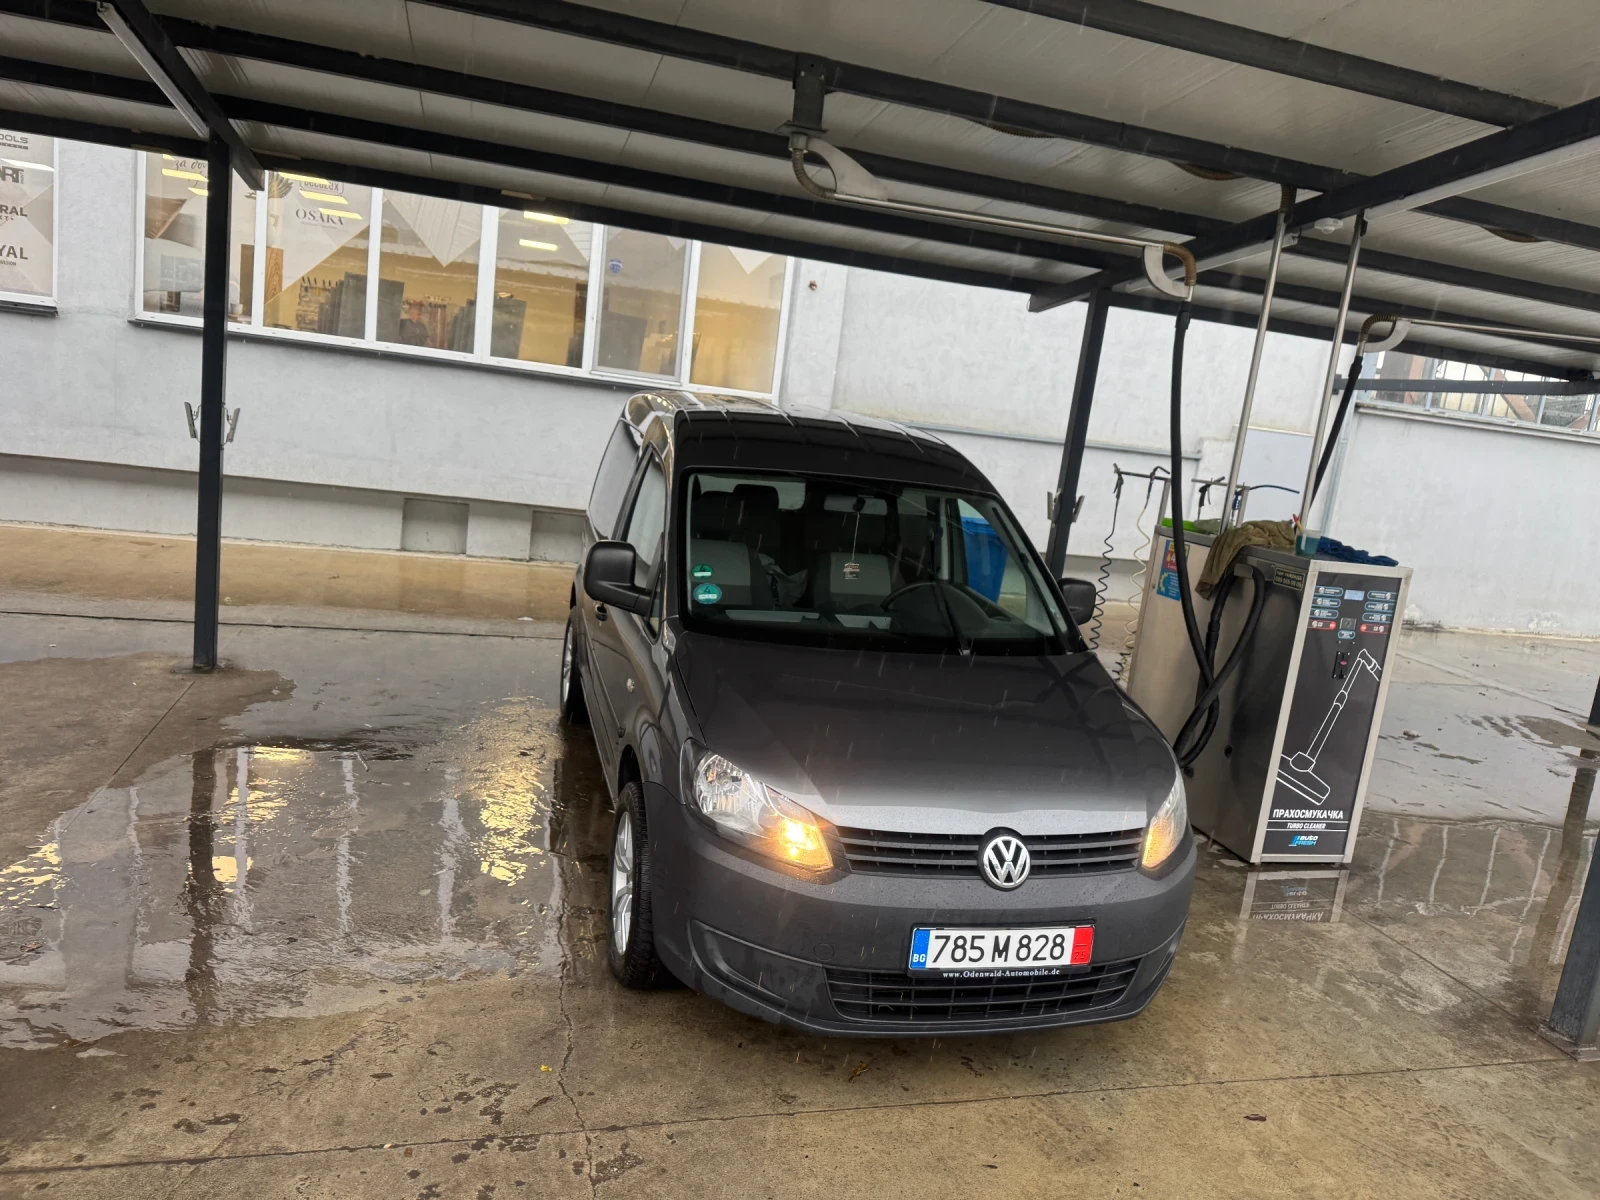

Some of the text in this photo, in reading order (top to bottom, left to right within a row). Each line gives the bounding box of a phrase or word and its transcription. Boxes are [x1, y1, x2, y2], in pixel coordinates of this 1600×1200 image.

[1273, 809, 1343, 819] ПРАХОСМУКАЧКА
[932, 934, 1065, 963] 785 M 828
[913, 954, 925, 963] BG
[942, 969, 1060, 978] www.Odenwald-Automobile.de
